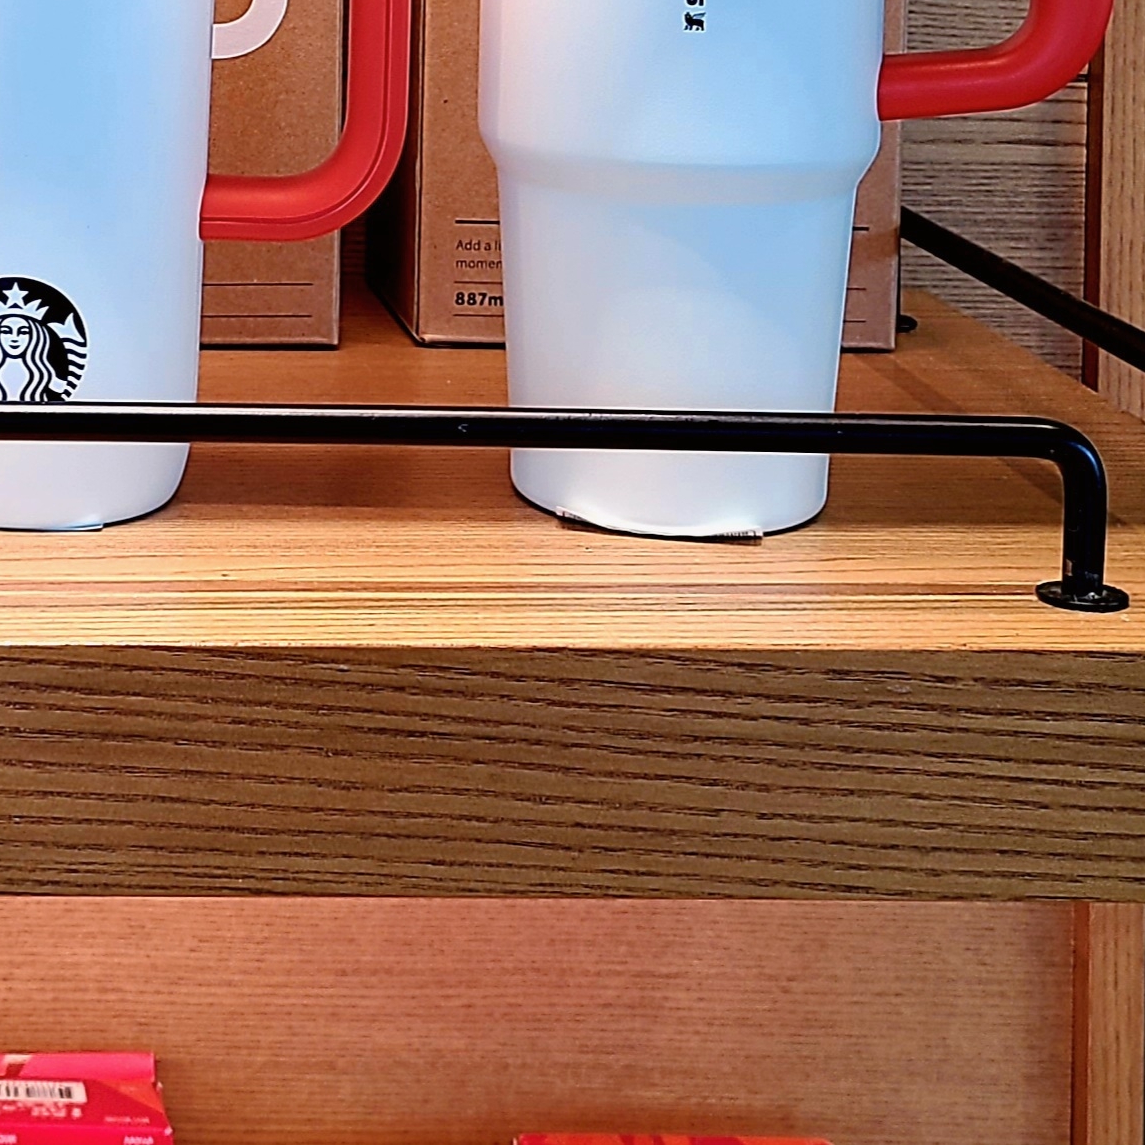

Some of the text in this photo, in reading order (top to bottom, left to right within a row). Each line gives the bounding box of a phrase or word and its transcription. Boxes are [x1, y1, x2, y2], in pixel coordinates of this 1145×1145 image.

[456, 239, 481, 251] Add
[483, 242, 492, 251] a
[456, 259, 503, 269] momen
[455, 291, 504, 307] 887m
